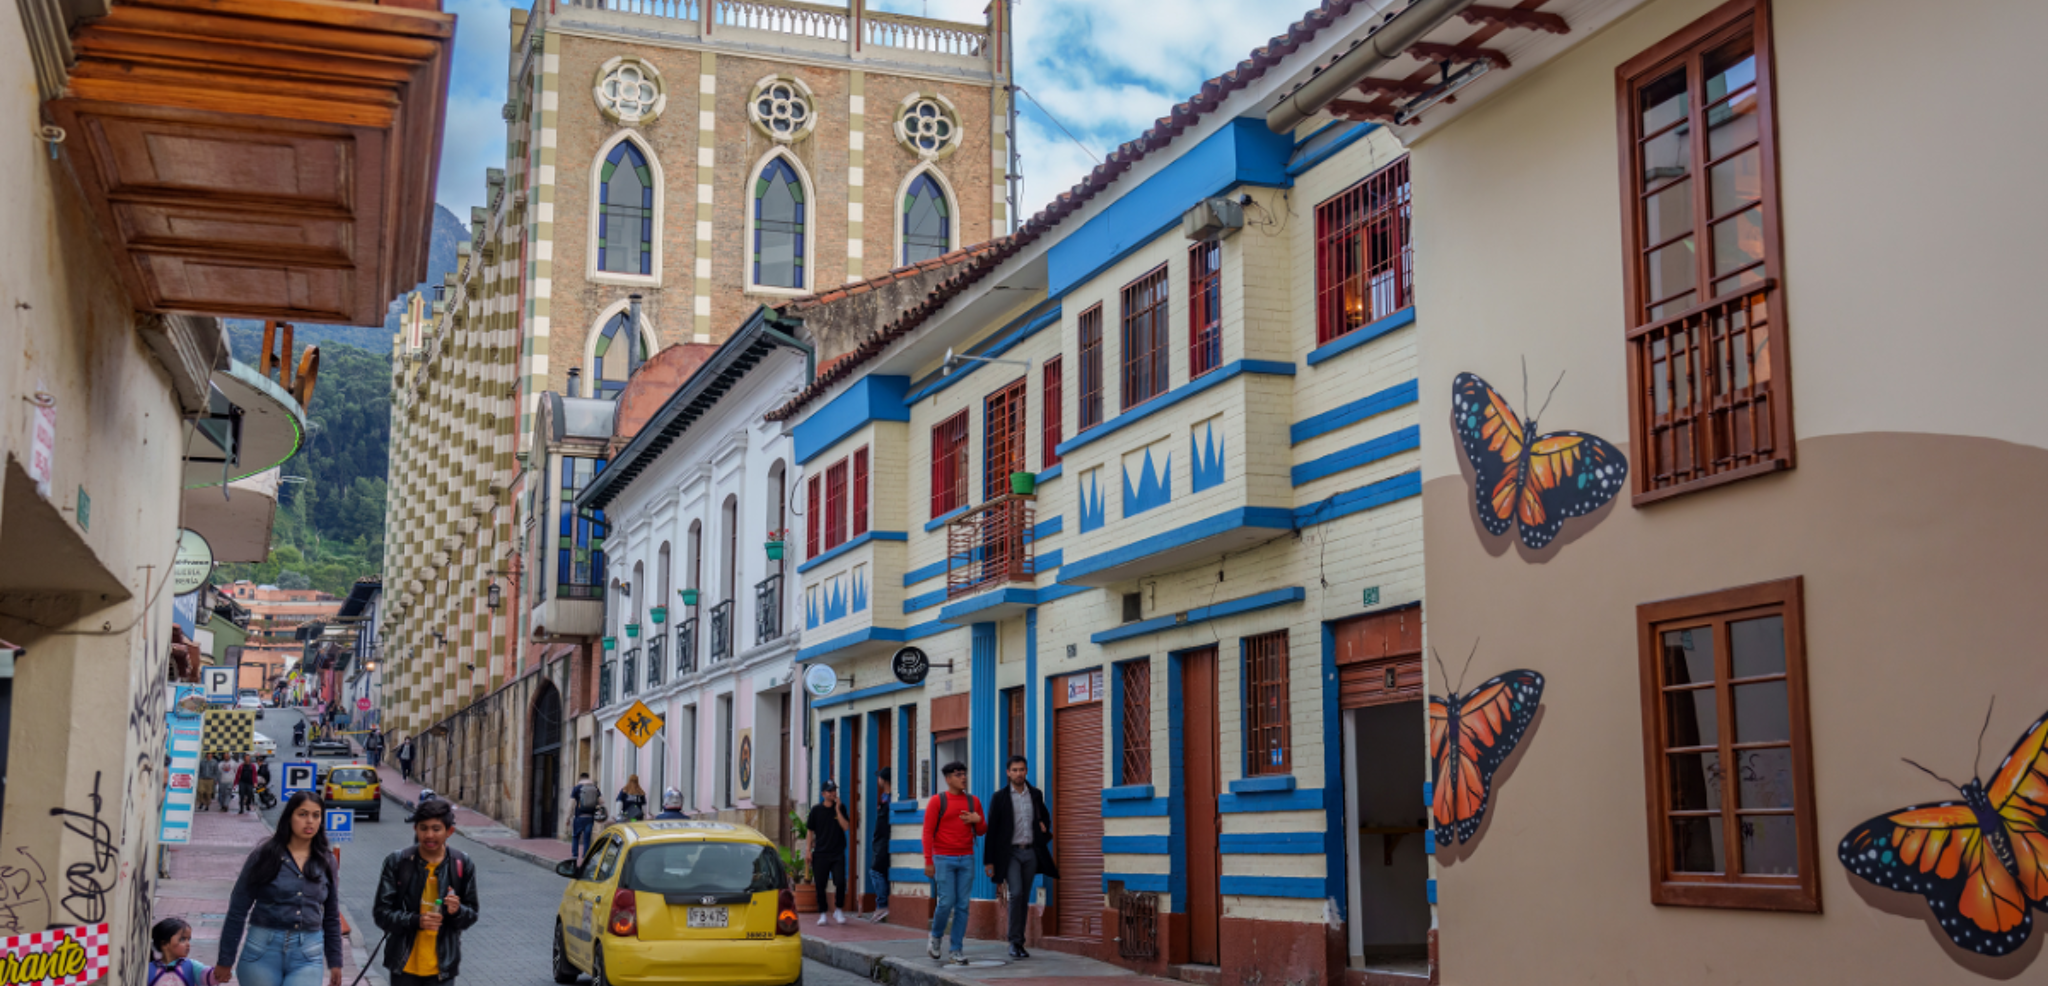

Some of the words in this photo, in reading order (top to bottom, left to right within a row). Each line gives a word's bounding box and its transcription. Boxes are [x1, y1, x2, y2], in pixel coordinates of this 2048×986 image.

[213, 672, 227, 692] P
[289, 767, 310, 787] P
[330, 813, 348, 830] P
